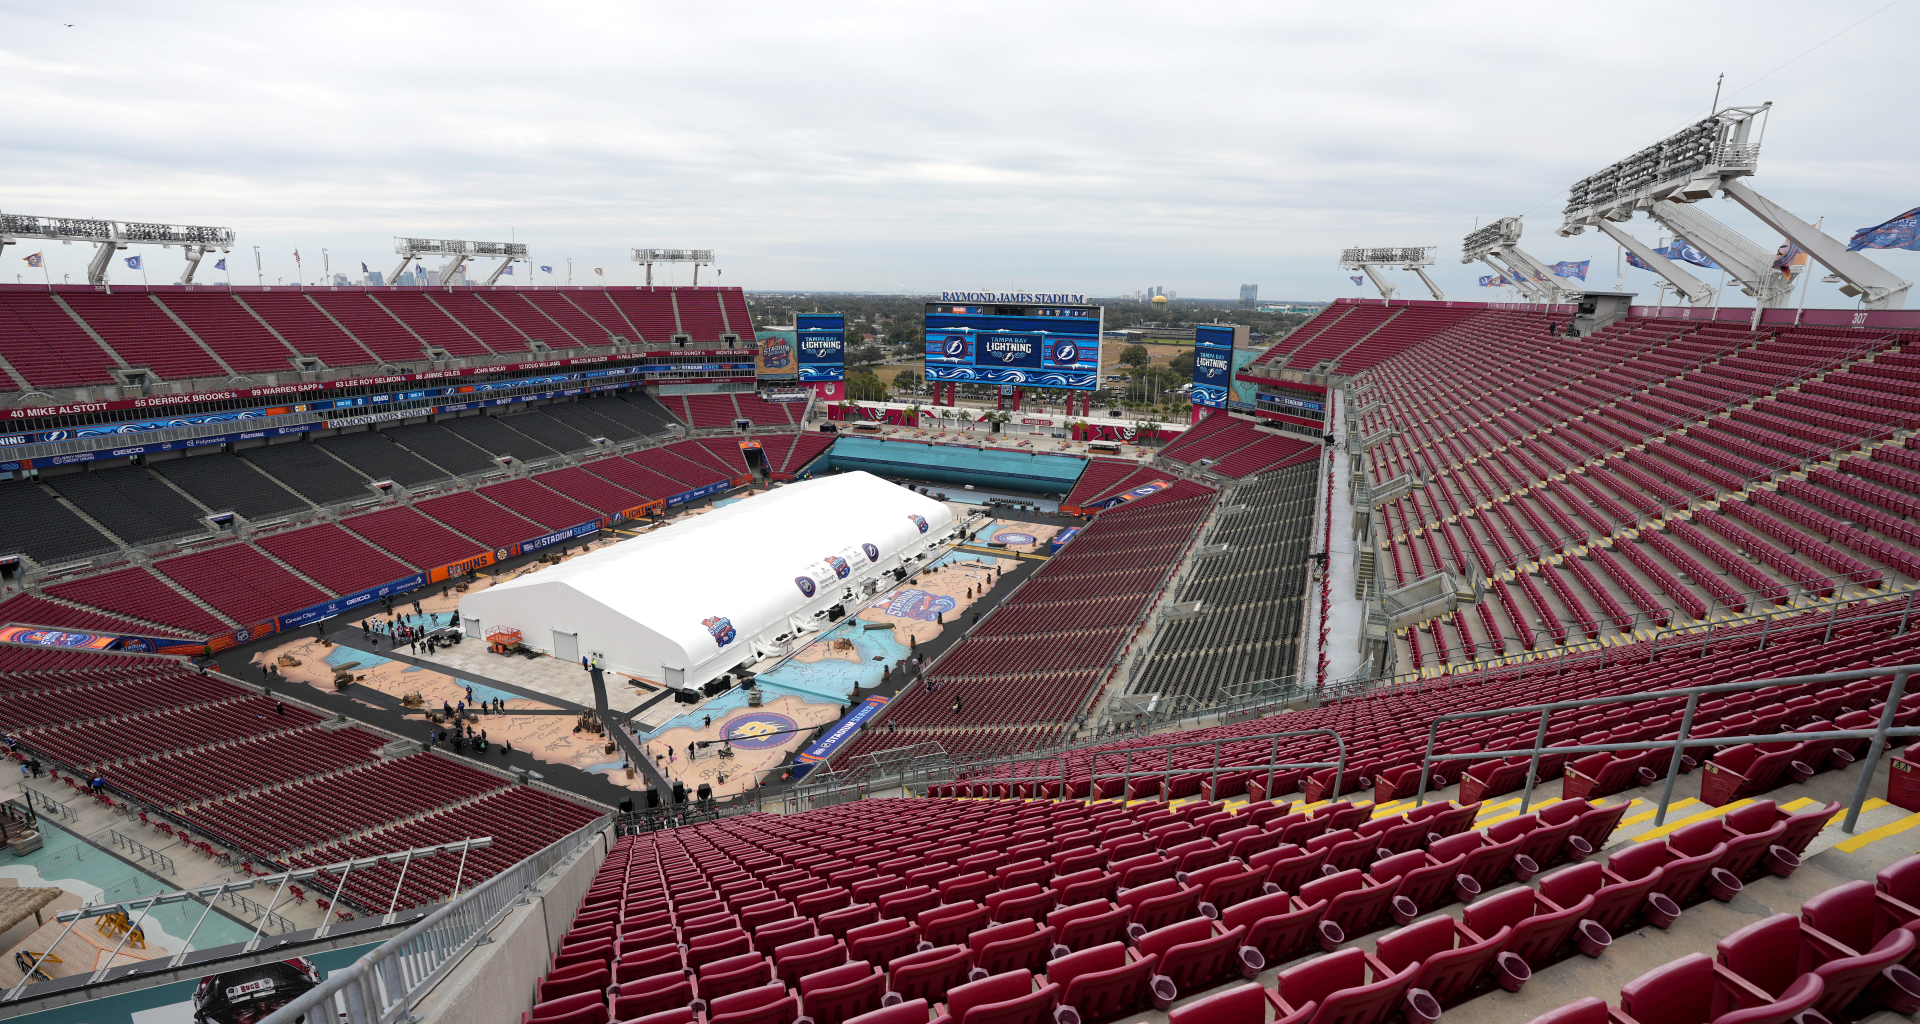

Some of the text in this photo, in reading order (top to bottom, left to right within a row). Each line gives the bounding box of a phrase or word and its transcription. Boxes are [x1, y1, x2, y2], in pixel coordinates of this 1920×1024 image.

[942, 292, 1084, 304] RAYMOND JAMES STADIUM
[1852, 313, 1868, 324] 307
[802, 341, 841, 350] LIGHTNING
[986, 342, 1032, 354] LIGHTNING
[1197, 357, 1227, 370] LIGHTNING
[374, 376, 401, 385] SELMON
[262, 385, 296, 395] WARREN
[298, 383, 318, 392] SAPP
[148, 395, 191, 406] DERRICK
[192, 392, 230, 402] BROOKS
[1284, 398, 1303, 406] STADIUM
[10, 403, 108, 418] 40 MIKE ALSTOTT
[330, 408, 432, 428] RAYMOND JAMES STADIUM
[240, 431, 265, 440] FASTENAL
[113, 447, 144, 456] GEICO
[542, 522, 596, 547] STADIUM SERIES
[447, 556, 488, 572] BRUINS
[346, 594, 370, 606] GEICO
[887, 589, 923, 617] STADIUM
[302, 611, 316, 620] Clips
[514, 717, 564, 743] Cross Check
[538, 726, 562, 739] Cape
[826, 721, 856, 744] STADIUM
[716, 763, 742, 780] Den
[1895, 761, 1908, 771] AA
